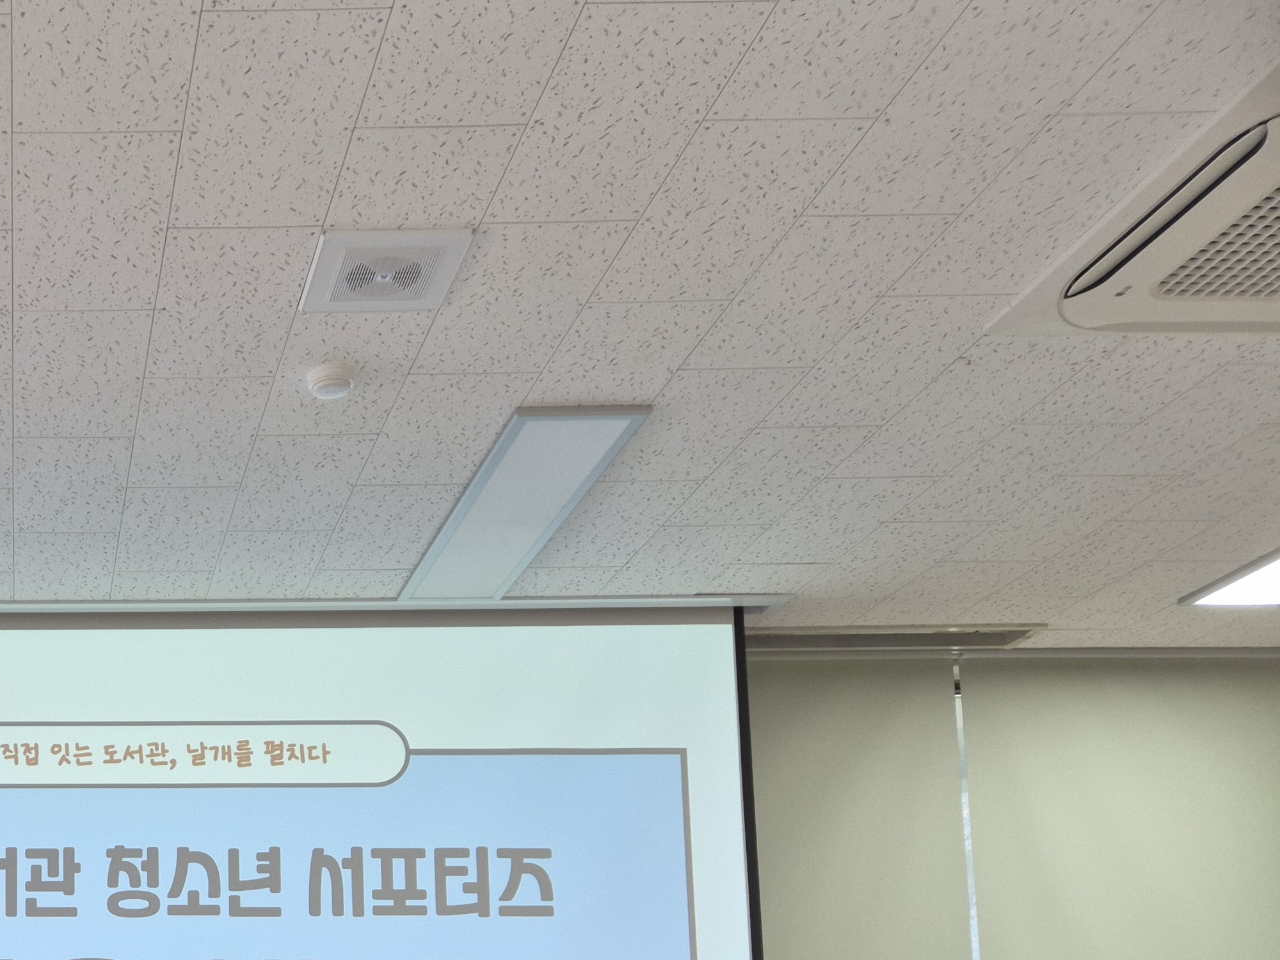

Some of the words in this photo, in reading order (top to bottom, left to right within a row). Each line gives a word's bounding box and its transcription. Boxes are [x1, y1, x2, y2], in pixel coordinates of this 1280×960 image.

[0, 742, 40, 767] 직접
[49, 742, 94, 767] 잇는
[102, 741, 178, 770] 도서관,
[186, 739, 254, 768] 날개를
[263, 739, 331, 766] 펼치다
[105, 845, 282, 918] 청소년
[308, 846, 555, 918] 서포터즈
